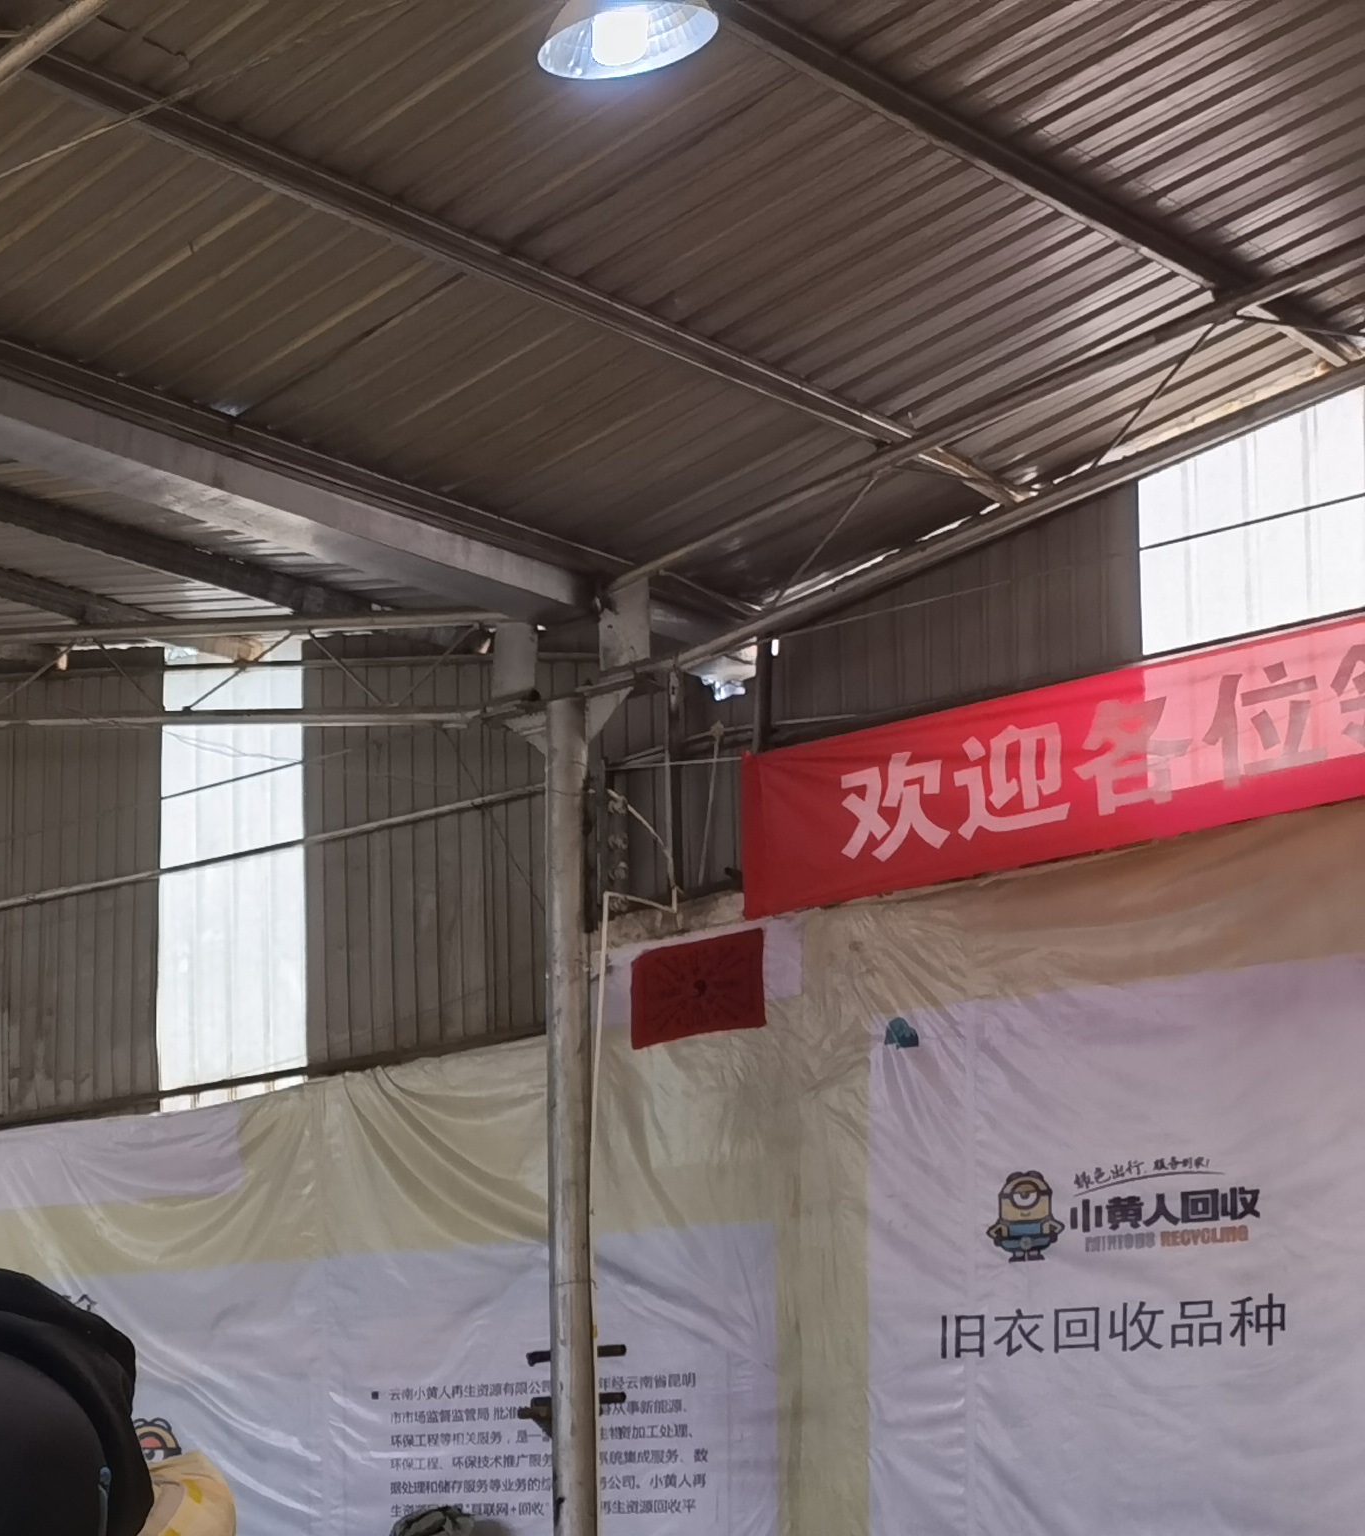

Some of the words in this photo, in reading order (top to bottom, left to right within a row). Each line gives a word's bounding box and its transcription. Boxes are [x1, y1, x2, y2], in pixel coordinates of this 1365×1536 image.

[1070, 1187, 1261, 1232] 小黄人回收
[1160, 1225, 1249, 1247] RECYCLING
[940, 1293, 1287, 1359] 旧衣回收品种
